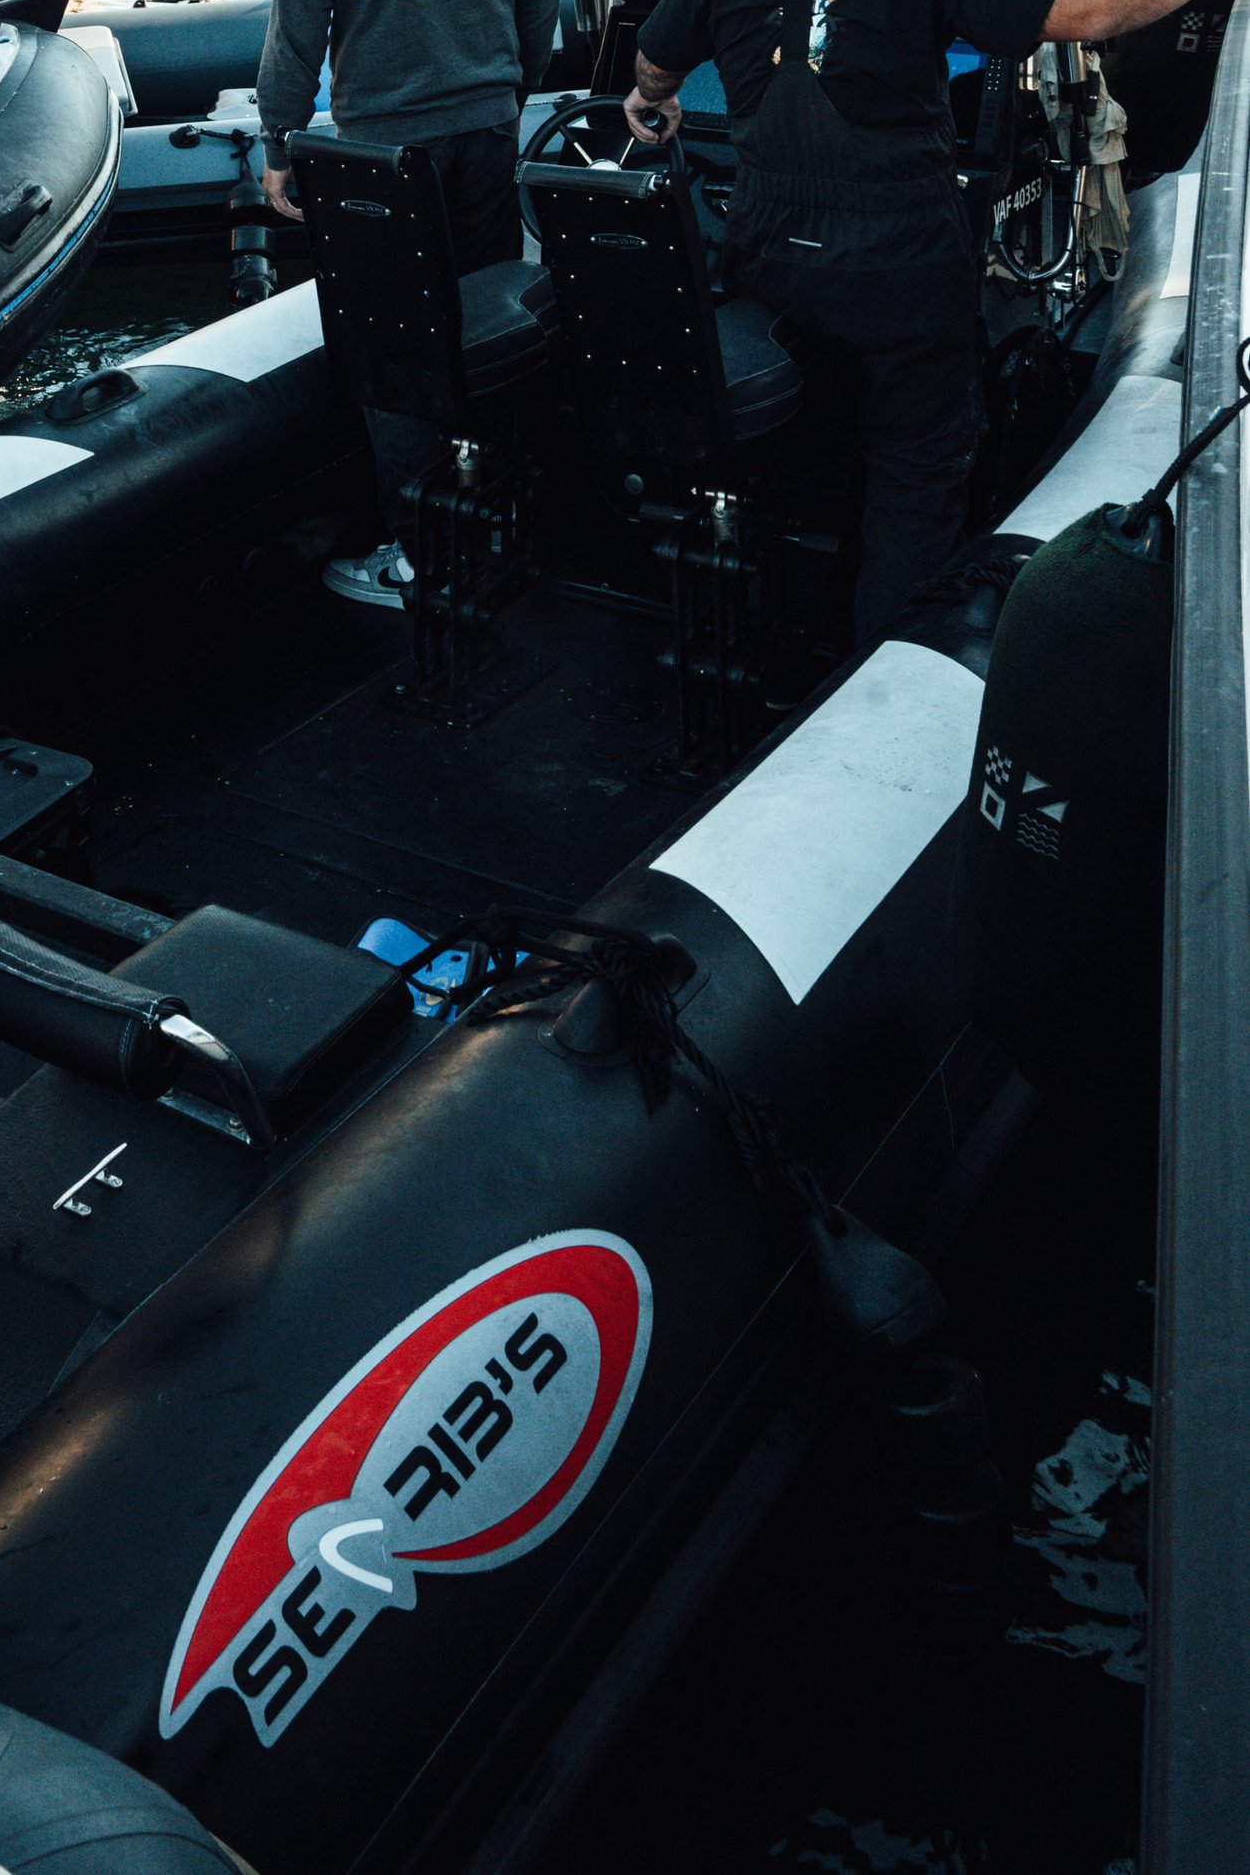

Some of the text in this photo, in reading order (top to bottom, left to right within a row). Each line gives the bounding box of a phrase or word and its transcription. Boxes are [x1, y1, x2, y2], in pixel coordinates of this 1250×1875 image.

[993, 177, 1042, 225] VAF 40353
[382, 1312, 568, 1522] RIB'S
